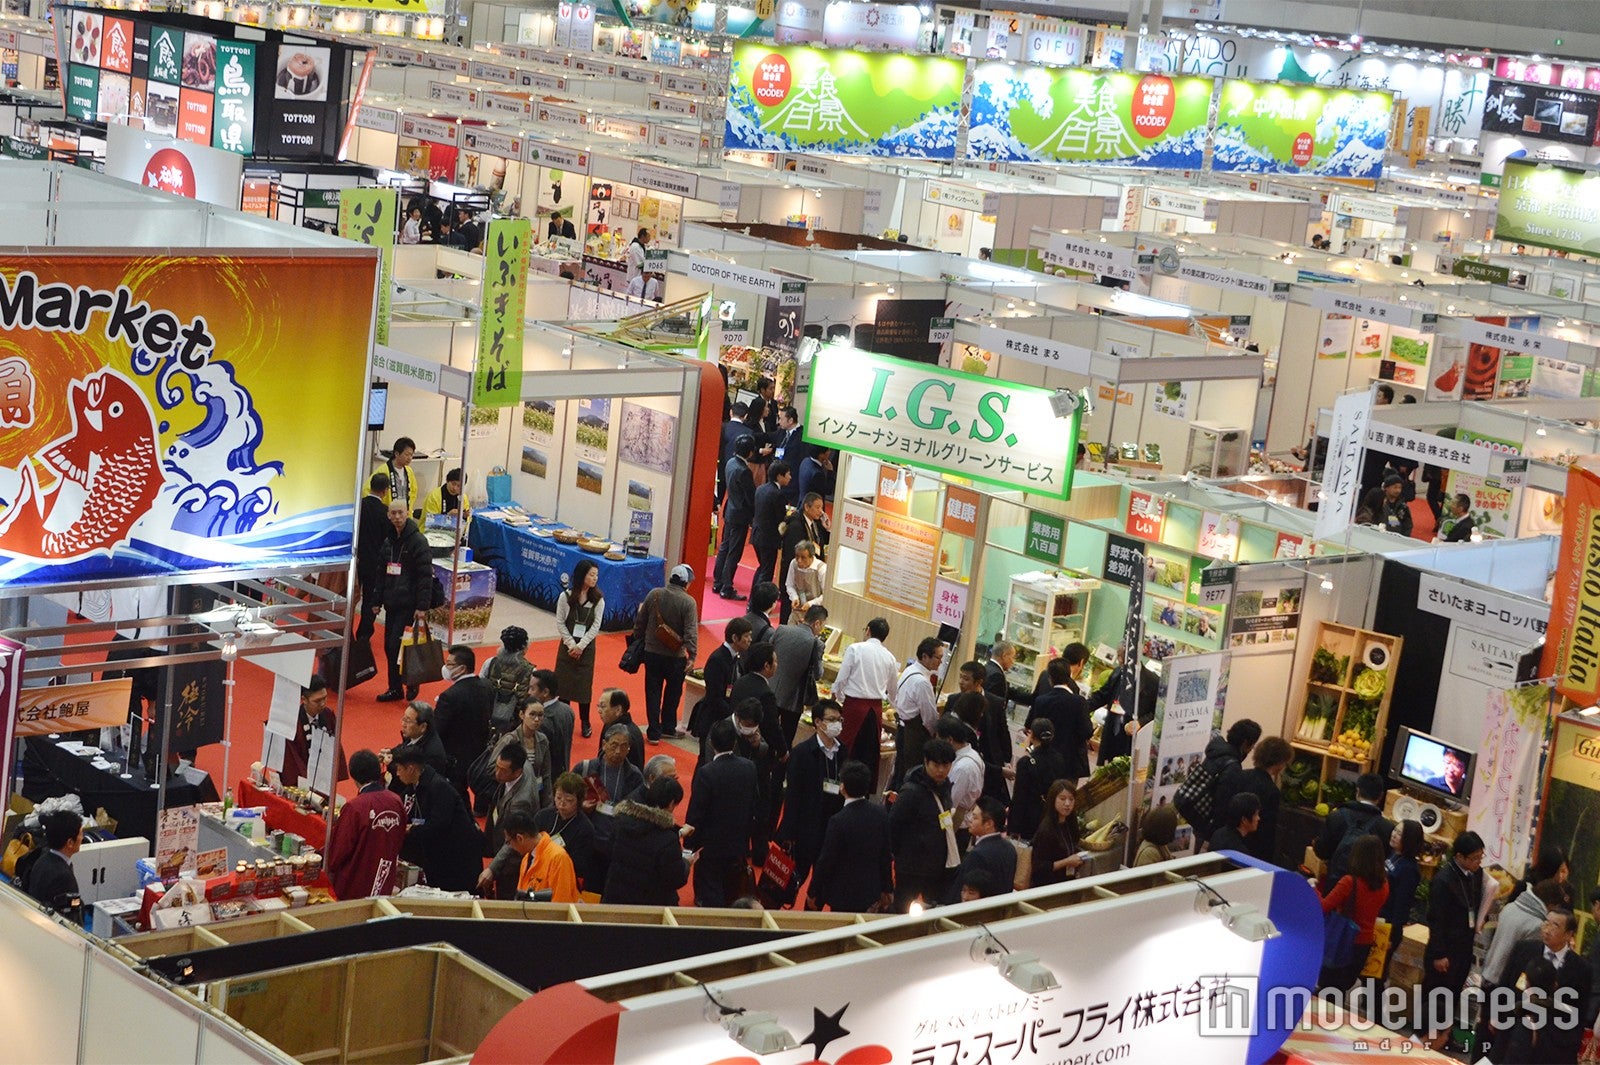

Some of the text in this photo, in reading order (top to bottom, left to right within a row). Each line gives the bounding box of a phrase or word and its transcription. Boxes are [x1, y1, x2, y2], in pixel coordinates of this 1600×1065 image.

[220, 45, 251, 55] TOTTORI
[1033, 36, 1075, 56] GIFU
[74, 75, 93, 88] TOTTORI
[756, 88, 785, 98] FOODEX
[73, 96, 92, 108] TOTTORI
[186, 101, 208, 114] TOTTORI
[217, 54, 251, 152] 鳥取県
[1441, 74, 1483, 136] 十勝
[1485, 93, 1522, 125] 釧路
[283, 112, 316, 125] TOTTORI
[1135, 115, 1167, 127] FOODEX
[184, 122, 206, 135] TOTTORI
[281, 133, 314, 146] TOTTORI
[1525, 221, 1583, 243] Since 1738
[648, 261, 664, 270] 9D65
[691, 261, 776, 291] DOCTOR OF THE EARTH
[784, 295, 801, 304] 9D66
[1334, 299, 1362, 313] 株式会社
[485, 230, 520, 393] いぶきそば
[0, 274, 213, 371] Market
[723, 333, 743, 343] 9D70
[933, 331, 950, 341] 9D67
[1485, 330, 1515, 345] 株式会社
[1005, 339, 1060, 361] 株式会社 まる
[859, 367, 1018, 448] I.G.S.
[817, 416, 1055, 486] インターナショナルグリーンサービス
[1474, 440, 1518, 455] HAPPY
[1335, 410, 1363, 514] SAITAMA
[1475, 490, 1509, 501] おいしくて
[947, 497, 977, 525] 健康
[844, 511, 870, 530] 機能性
[1136, 522, 1152, 534] しい
[845, 526, 866, 543] 野菜
[1031, 521, 1061, 541] 業務用
[1029, 538, 1058, 556] 八百屋
[941, 590, 959, 605] 身体
[1205, 589, 1226, 601] 9E77
[935, 602, 961, 620] きれい
[1428, 587, 1548, 635] さいたまヨーロッパ野
[1470, 638, 1520, 661] SAITAM
[1568, 603, 1600, 687] Italia
[1168, 704, 1209, 719] SAITAMA
